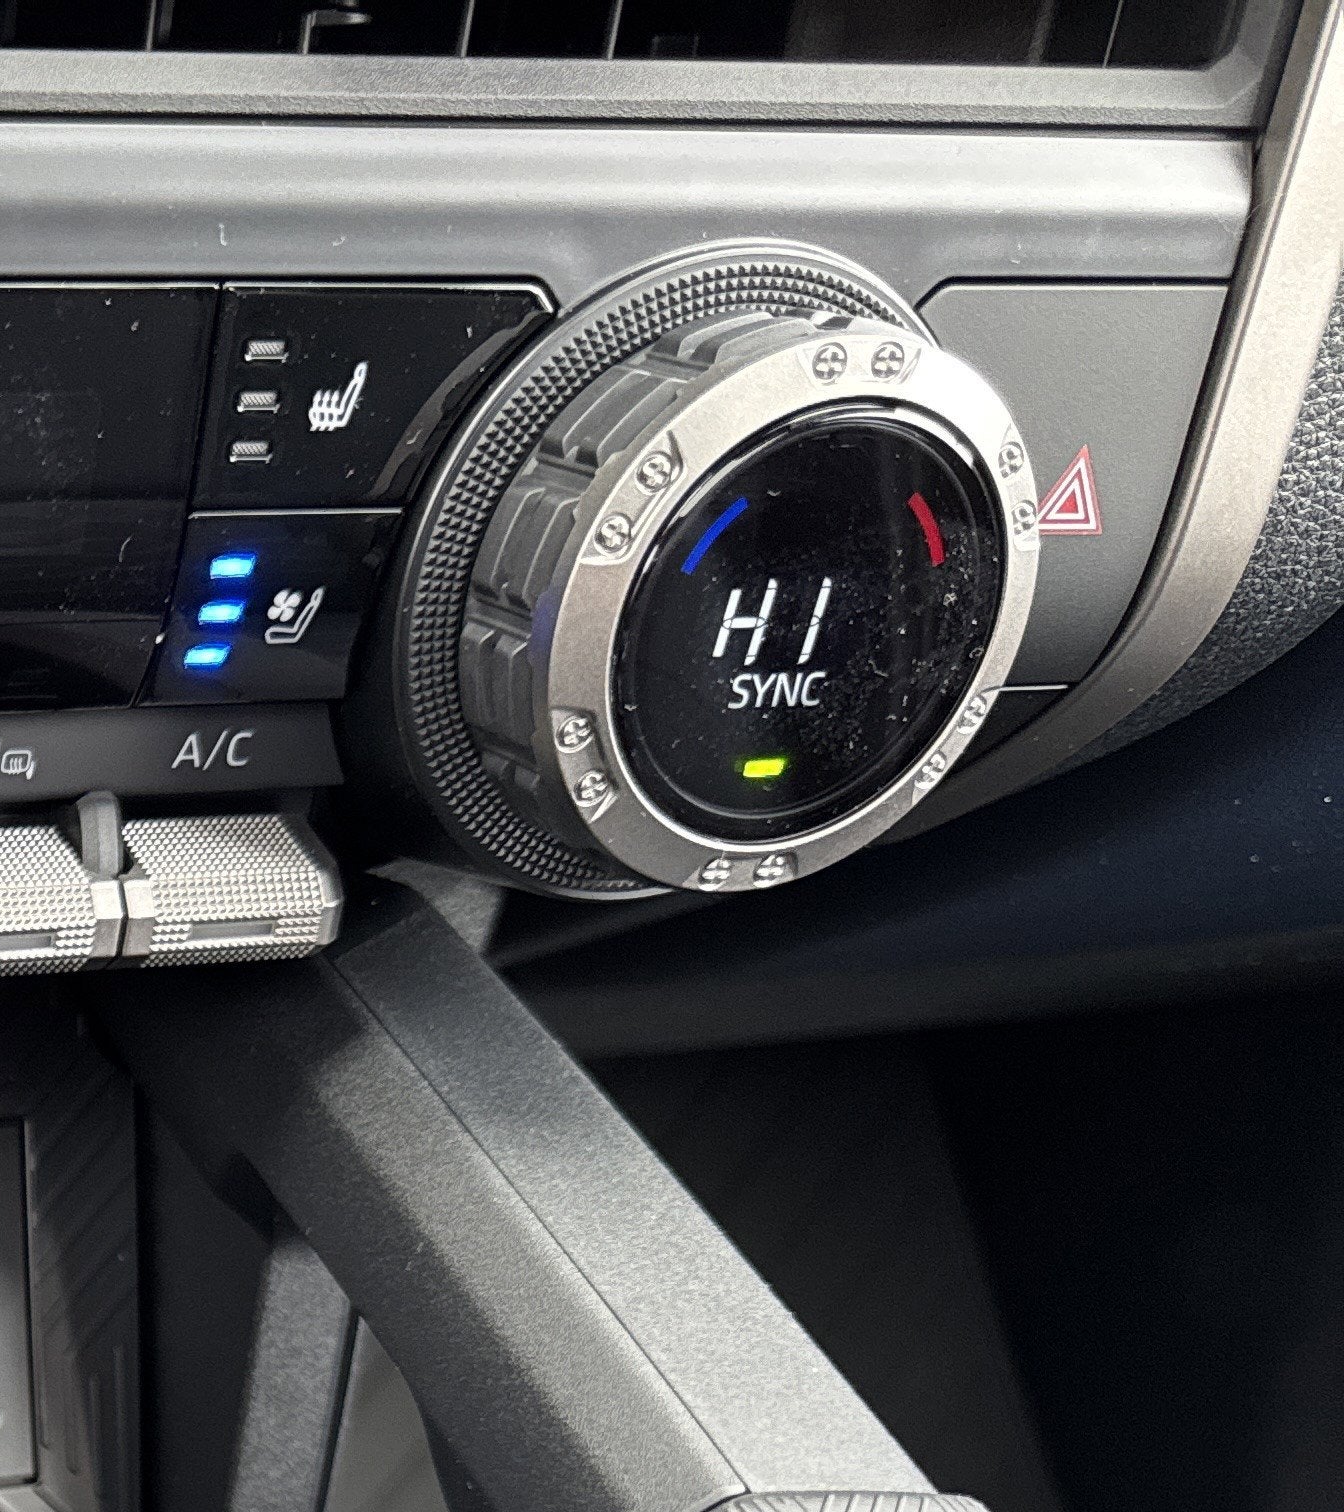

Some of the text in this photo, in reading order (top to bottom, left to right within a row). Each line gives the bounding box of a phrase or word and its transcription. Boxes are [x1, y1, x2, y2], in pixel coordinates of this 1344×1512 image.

[712, 576, 833, 666] HI
[727, 671, 828, 710] SYNC
[171, 729, 255, 771] A/C
